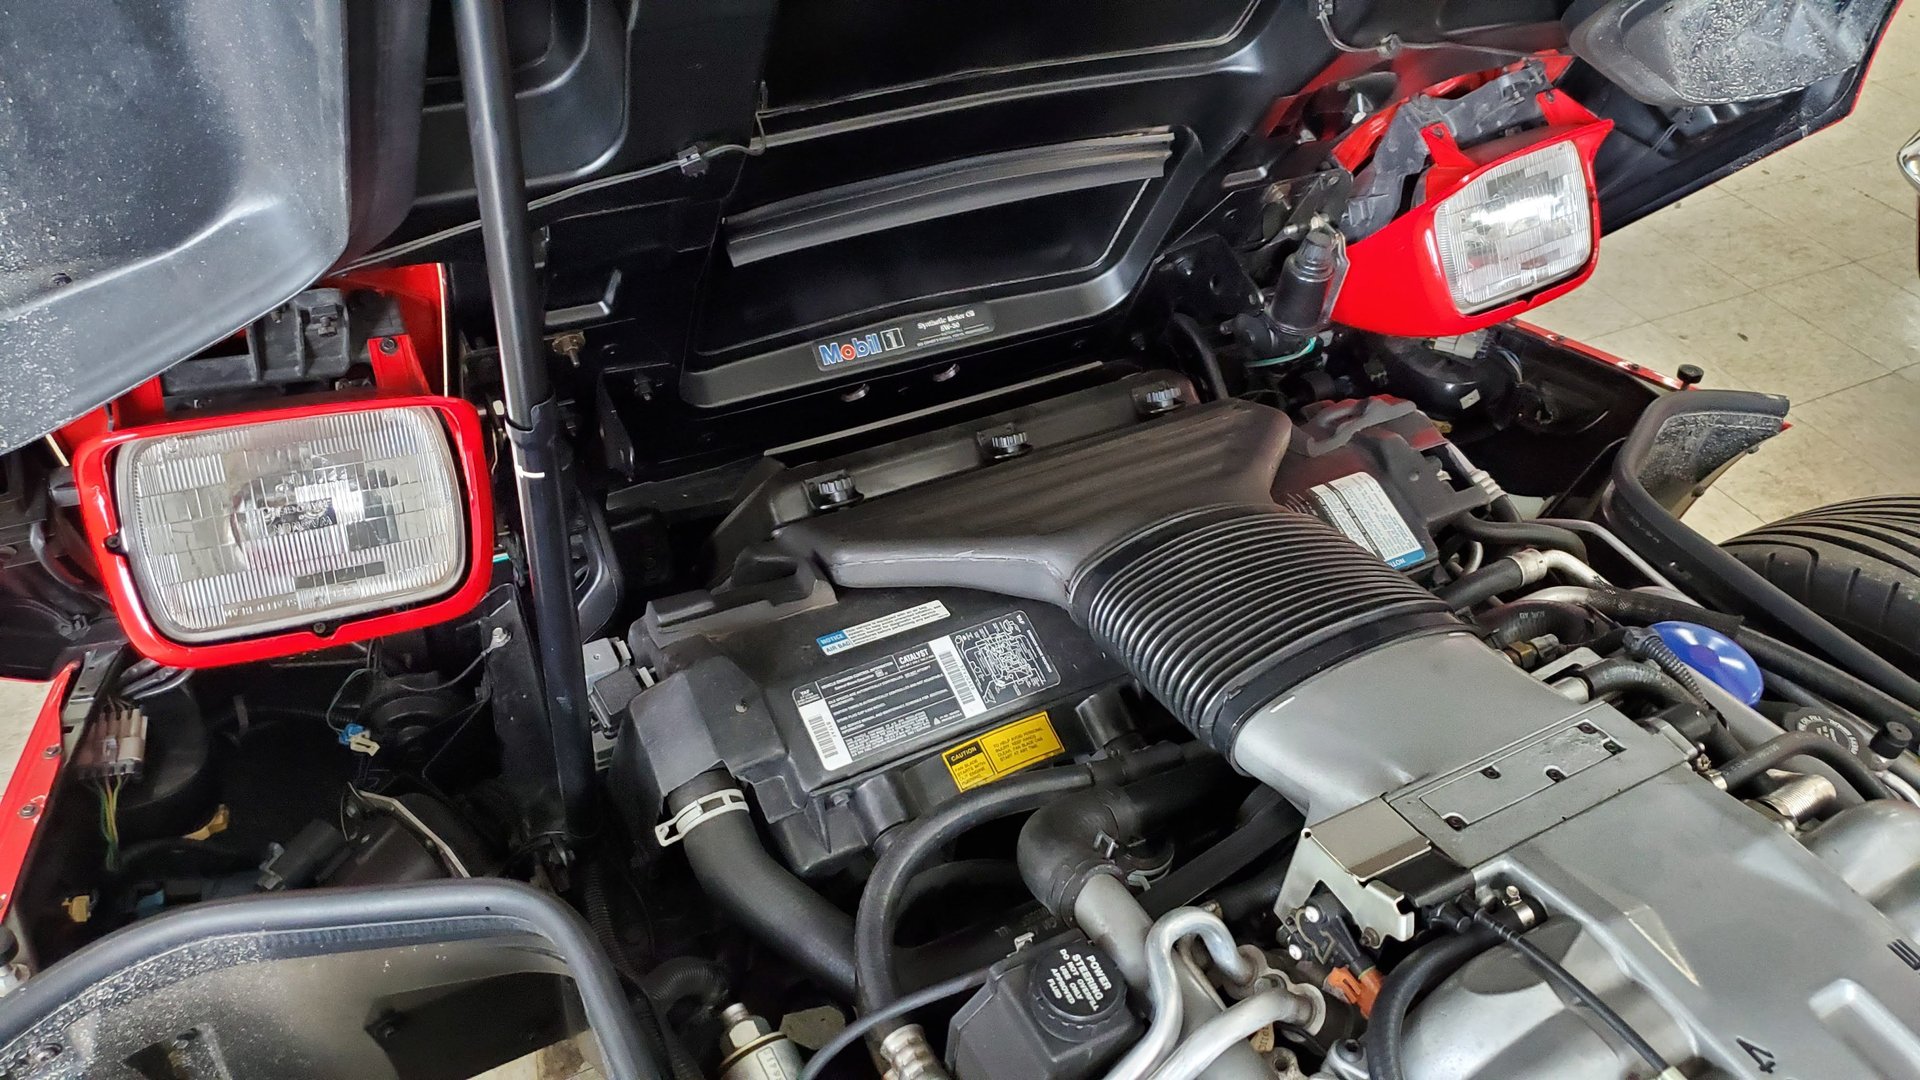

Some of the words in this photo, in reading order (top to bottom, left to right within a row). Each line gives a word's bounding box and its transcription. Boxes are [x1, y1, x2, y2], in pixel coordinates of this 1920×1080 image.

[917, 317, 947, 330] Synthetic
[947, 314, 965, 322] Motor
[818, 333, 883, 366] Mobil
[821, 633, 843, 645] NOTICE
[899, 649, 928, 664] CATALYST
[951, 747, 977, 762] CAUTION
[1047, 978, 1062, 998] FLUID
[1051, 969, 1075, 1004] APPROVED
[1060, 949, 1070, 960] DO
[1067, 961, 1079, 975] NOT
[1077, 979, 1099, 1011] OVERFILL
[1060, 965, 1071, 980] USE
[1069, 982, 1083, 999] ONLY
[1072, 954, 1103, 1000] STEERING
[1086, 955, 1112, 990] POWER
